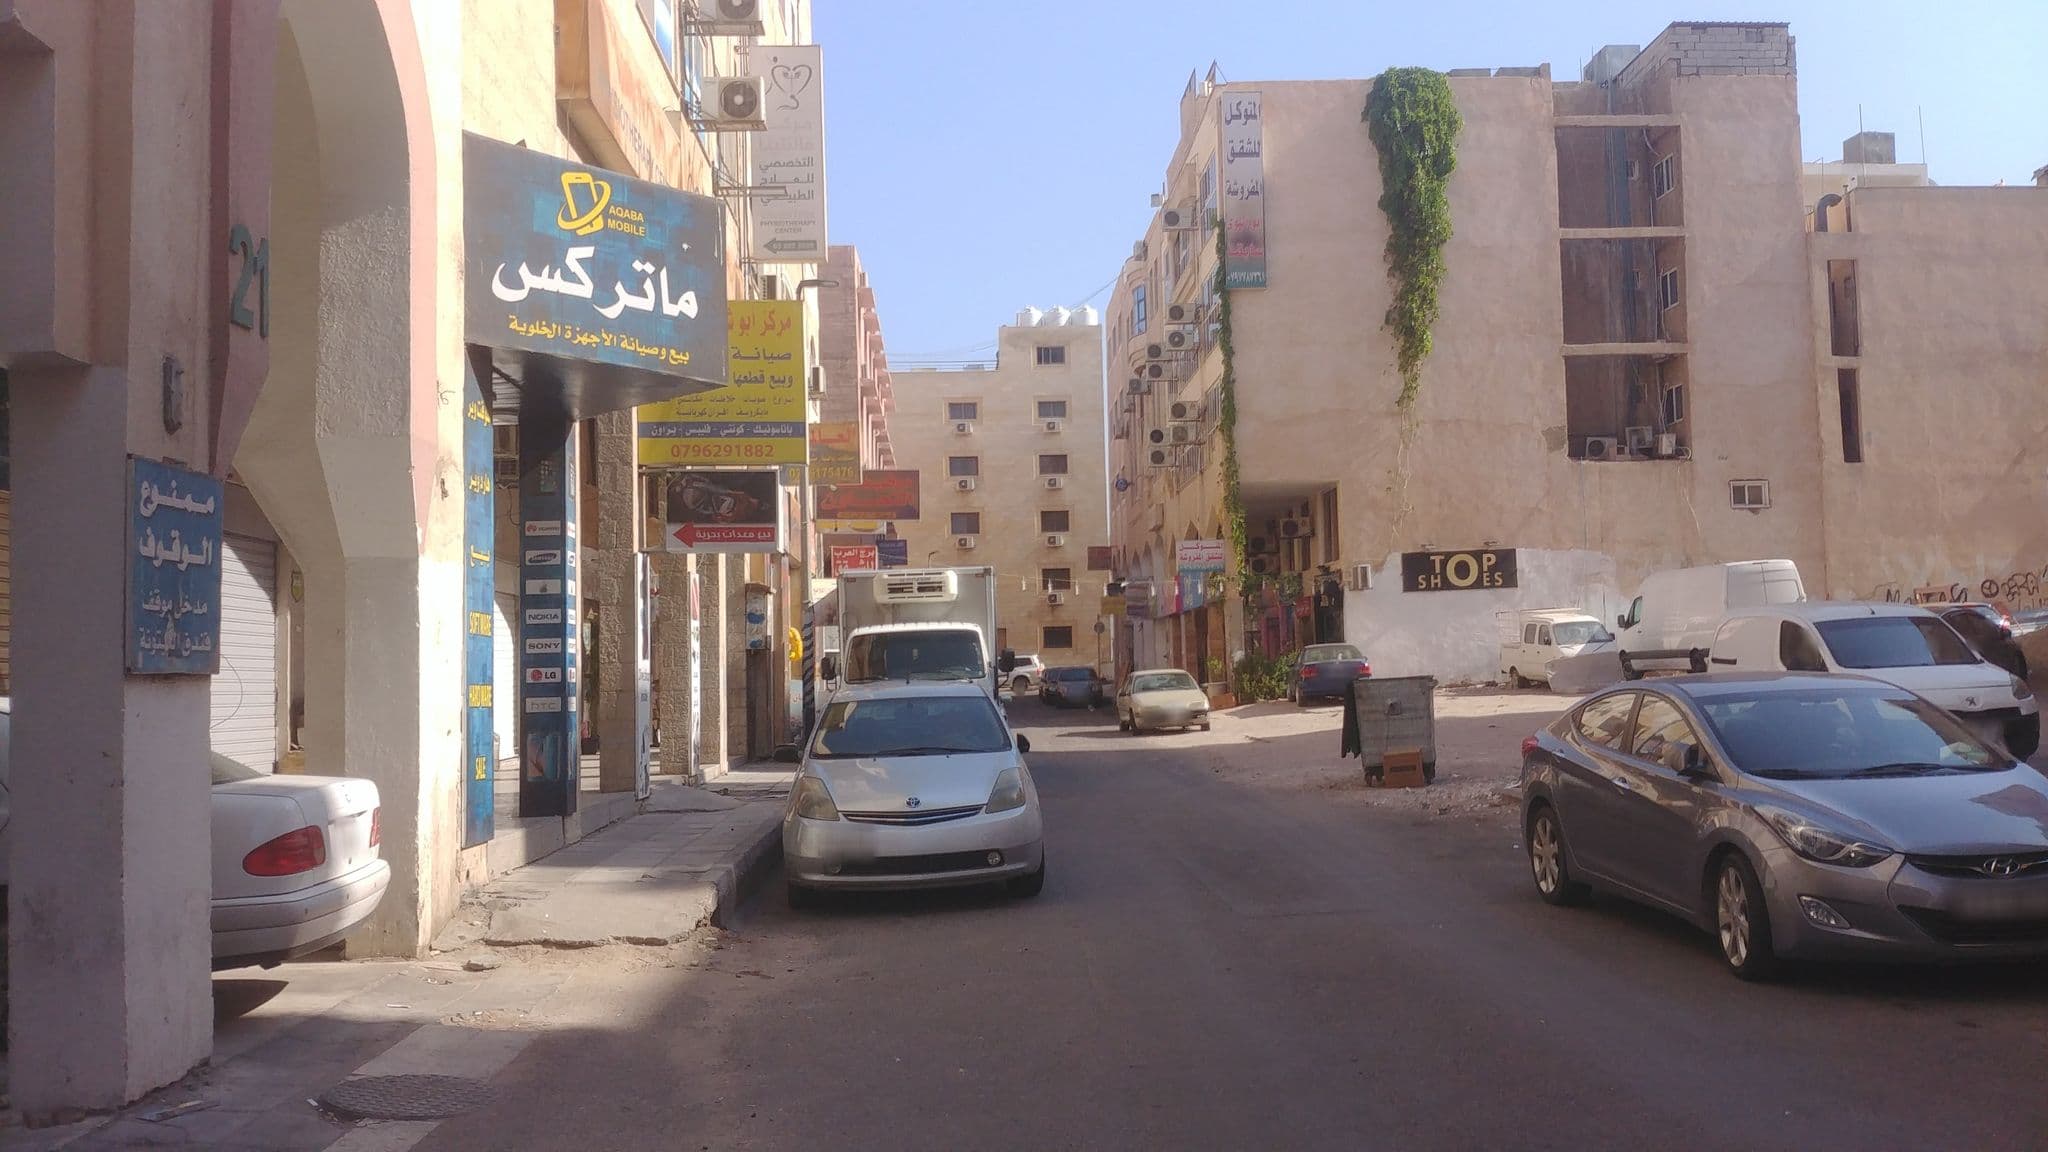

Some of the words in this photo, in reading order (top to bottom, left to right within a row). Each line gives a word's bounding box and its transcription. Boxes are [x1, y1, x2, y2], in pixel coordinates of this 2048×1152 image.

[1224, 100, 1262, 127] المتوكل
[1226, 138, 1261, 164] للشقق
[758, 156, 814, 173] التخصصي
[608, 205, 645, 223] AQABA
[607, 219, 647, 237] MOBILE
[230, 223, 270, 338] 21
[491, 246, 699, 319] ماتركس
[508, 314, 562, 339] الخلوية
[760, 309, 791, 337] مركز
[620, 334, 667, 363] وصيانة
[668, 350, 690, 365] بيع
[731, 346, 792, 364] صيانة
[768, 374, 794, 390] وبيع
[670, 444, 775, 458] 0796291882
[139, 479, 215, 518] ممنوع
[139, 526, 213, 572] الوقوف
[833, 548, 858, 560] العرب
[859, 549, 875, 560] برج
[1429, 553, 1497, 585] TOP
[174, 592, 208, 619] مدخل
[527, 613, 560, 621] NOKIA
[182, 632, 211, 657] فندق
[527, 642, 561, 650] SONY
[544, 671, 557, 680] LG
